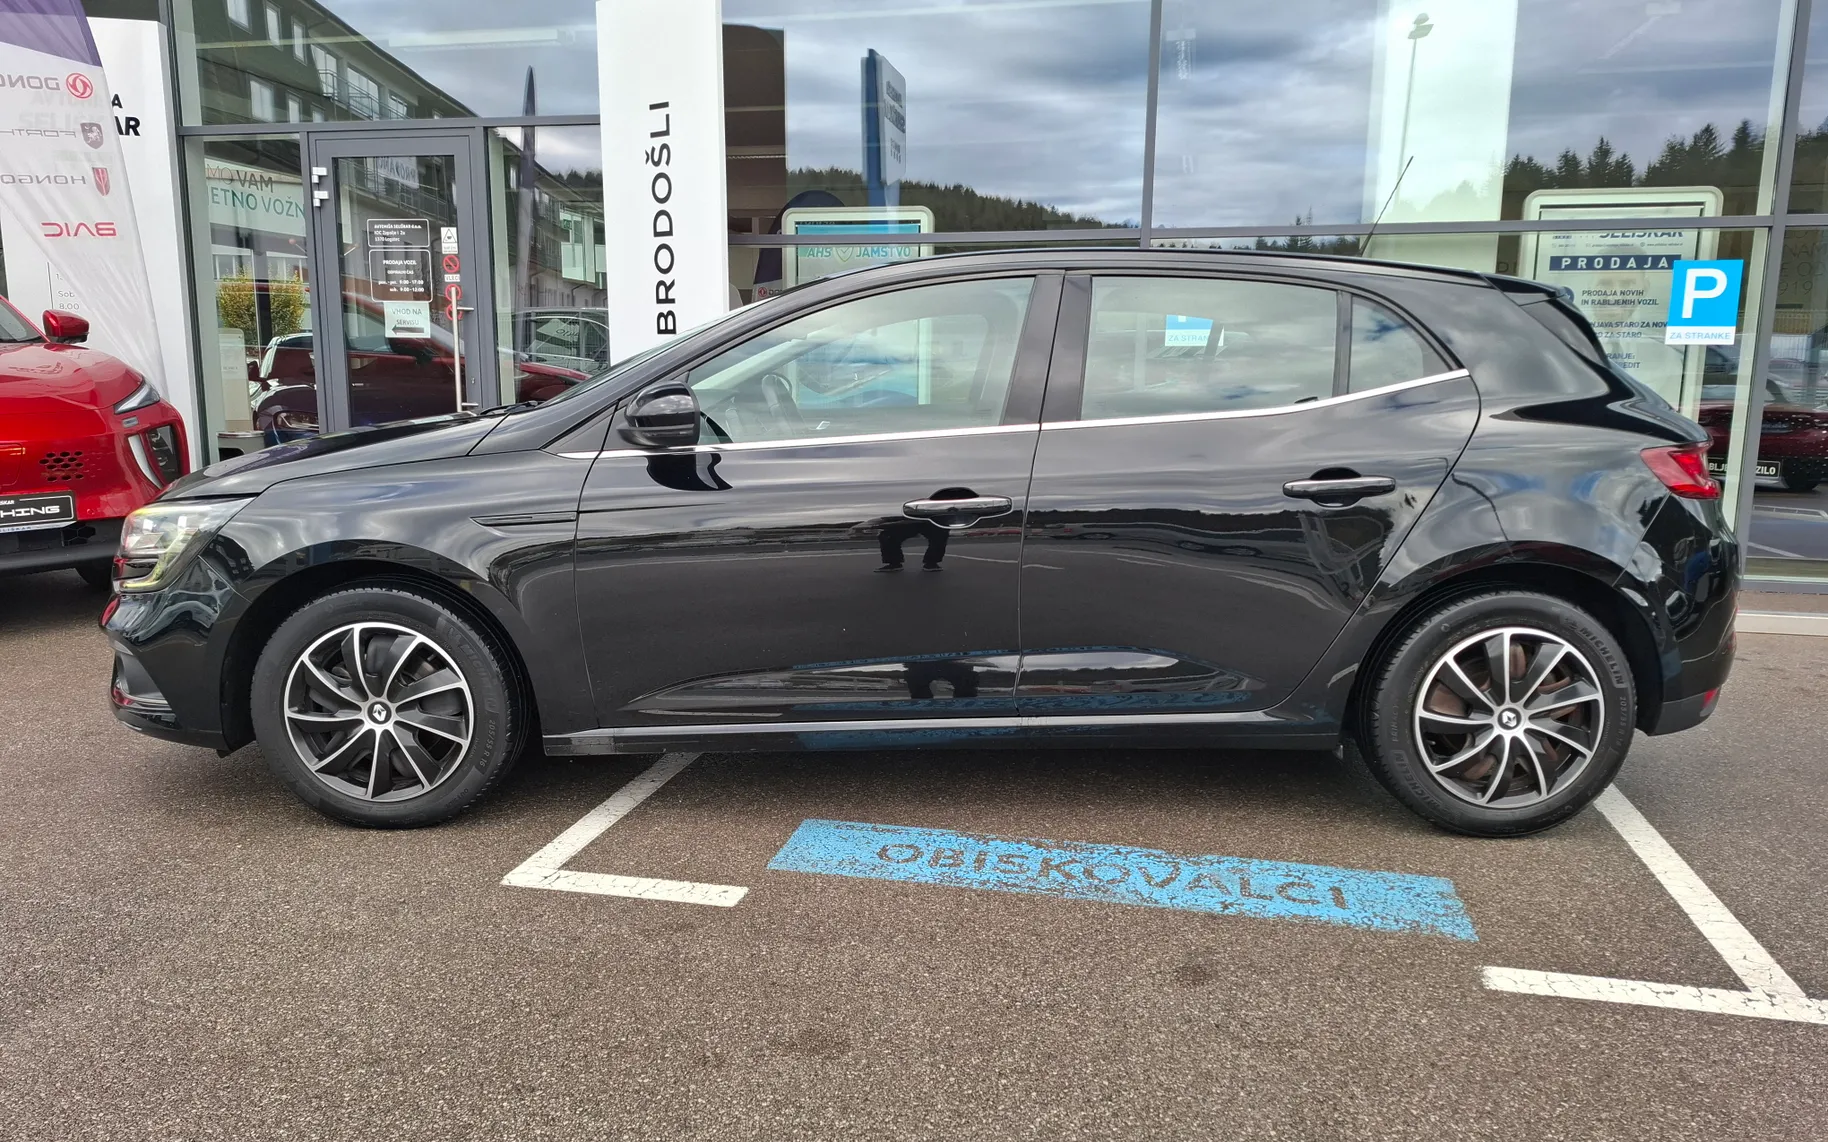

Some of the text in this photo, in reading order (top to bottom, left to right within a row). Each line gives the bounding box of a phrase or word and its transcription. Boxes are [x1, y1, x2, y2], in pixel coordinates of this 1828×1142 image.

[236, 169, 274, 194] VAM
[645, 101, 677, 335] BRODOŠLI
[807, 246, 911, 258] AHS JAMSTVO
[1561, 256, 1669, 269] PRODAJA
[1582, 289, 1618, 297] PRODAJA
[1681, 268, 1728, 319] P
[1670, 332, 1731, 340] ZA STRANKE
[876, 844, 1348, 909] OBISKOVALCI
